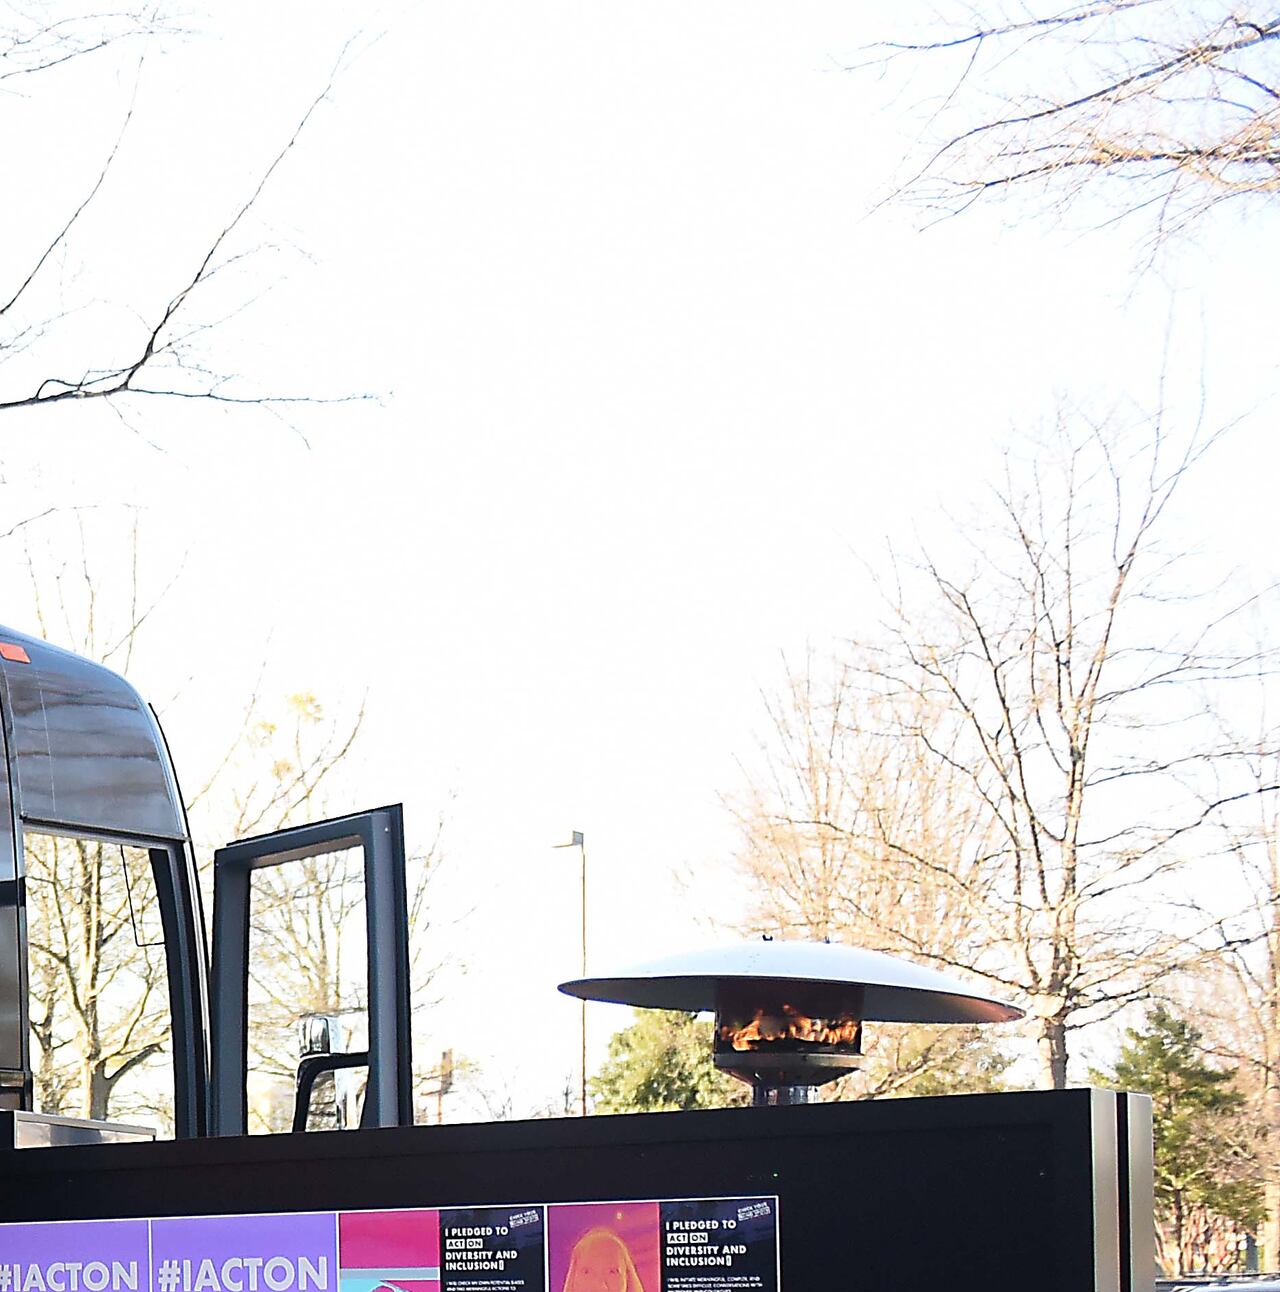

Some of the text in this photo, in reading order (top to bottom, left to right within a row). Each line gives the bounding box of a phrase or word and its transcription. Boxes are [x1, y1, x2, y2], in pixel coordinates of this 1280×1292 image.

[673, 1221, 719, 1230] PLEDGED
[722, 1220, 737, 1229] TO
[451, 1227, 493, 1236] PLEDGED
[495, 1226, 509, 1235] TO
[445, 1250, 518, 1260] DIVERSITY AND
[666, 1245, 747, 1255] DIVERSITY AND
[157, 1255, 328, 1292] #IACTON
